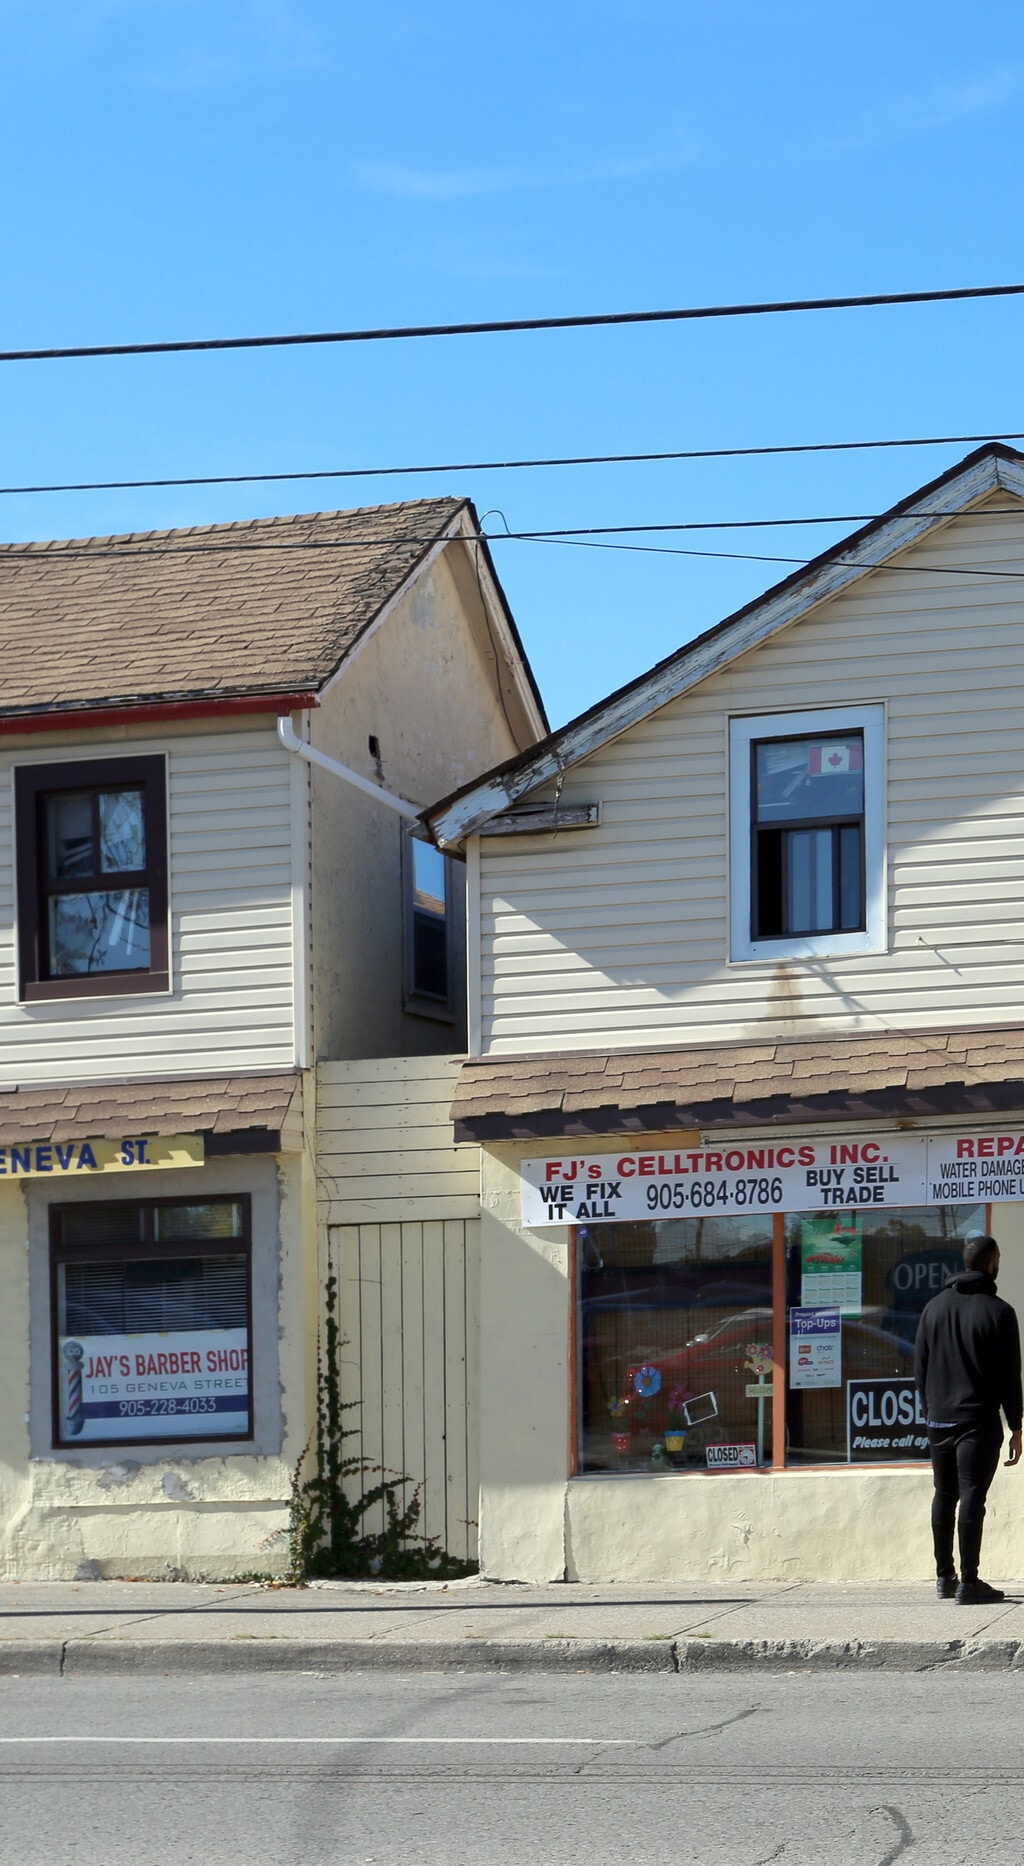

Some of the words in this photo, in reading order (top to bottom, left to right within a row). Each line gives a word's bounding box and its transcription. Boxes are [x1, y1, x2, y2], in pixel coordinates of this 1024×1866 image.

[121, 1140, 151, 1166] ST.
[545, 1160, 602, 1182] FJ's
[617, 1146, 815, 1177] CELLTRONICS
[830, 1142, 889, 1165] INC.
[806, 1168, 845, 1187] BUY
[853, 1165, 899, 1184] SELL
[940, 1161, 977, 1179] WATER
[539, 1185, 574, 1203] WE
[586, 1181, 622, 1200] FIX
[820, 1185, 885, 1205] TRADE
[932, 1182, 975, 1200] MOBILE
[978, 1178, 1016, 1197] PHONE
[548, 1203, 567, 1220] IT
[576, 1200, 616, 1219] ALL
[795, 1318, 836, 1331] Top-Ups
[86, 1354, 130, 1379] JAY'S
[136, 1351, 202, 1376] BARBER
[90, 1384, 119, 1394] 105
[126, 1381, 188, 1393] GENEVA
[119, 1397, 216, 1416] 905-228-4033
[852, 1436, 890, 1449] Please
[892, 1434, 914, 1447] call
[914, 1436, 930, 1449] ag
[707, 1447, 738, 1462] CLOSED
